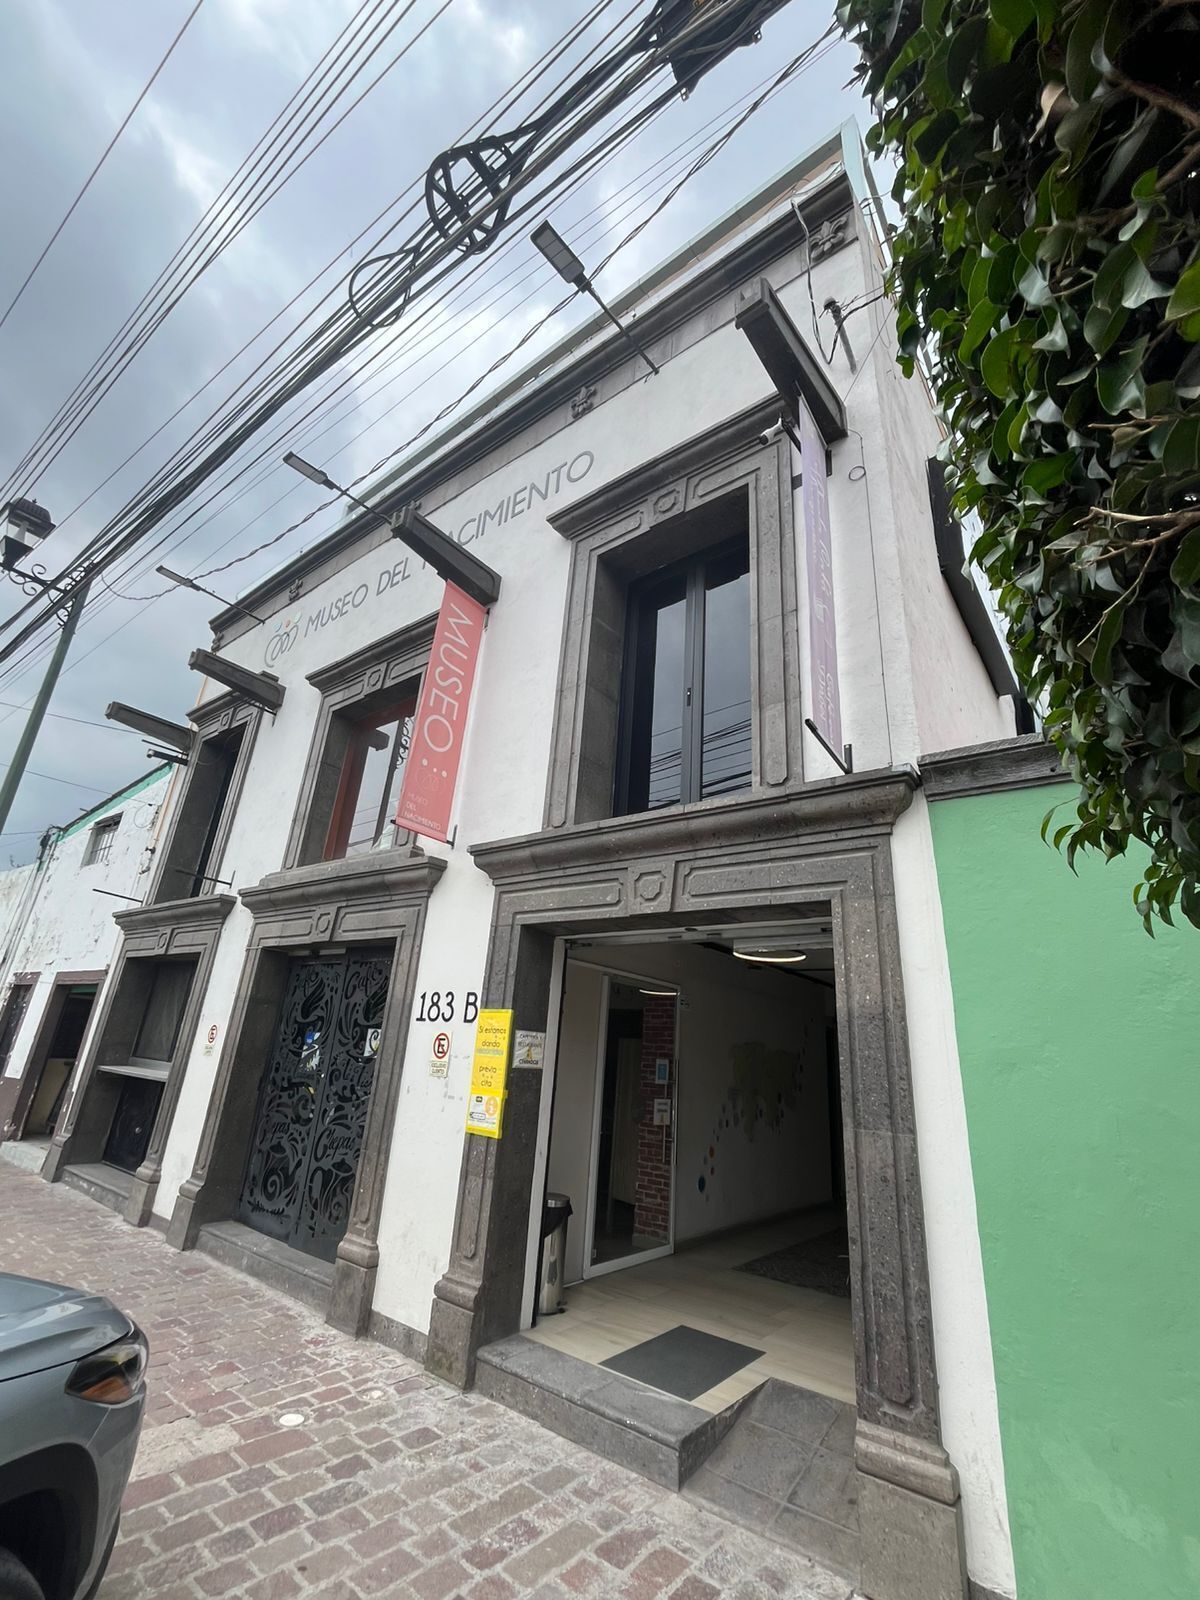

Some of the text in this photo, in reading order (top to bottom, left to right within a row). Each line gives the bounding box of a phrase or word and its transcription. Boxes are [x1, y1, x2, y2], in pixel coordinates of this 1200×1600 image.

[304, 451, 595, 639] MUSEO DEL CIMIENTO
[423, 602, 474, 753] MUSEO
[406, 800, 417, 811] DEL
[415, 991, 479, 1023] 183 B
[481, 1039, 501, 1048] dando
[478, 1065, 498, 1074] previa
[480, 1079, 492, 1088] cita
